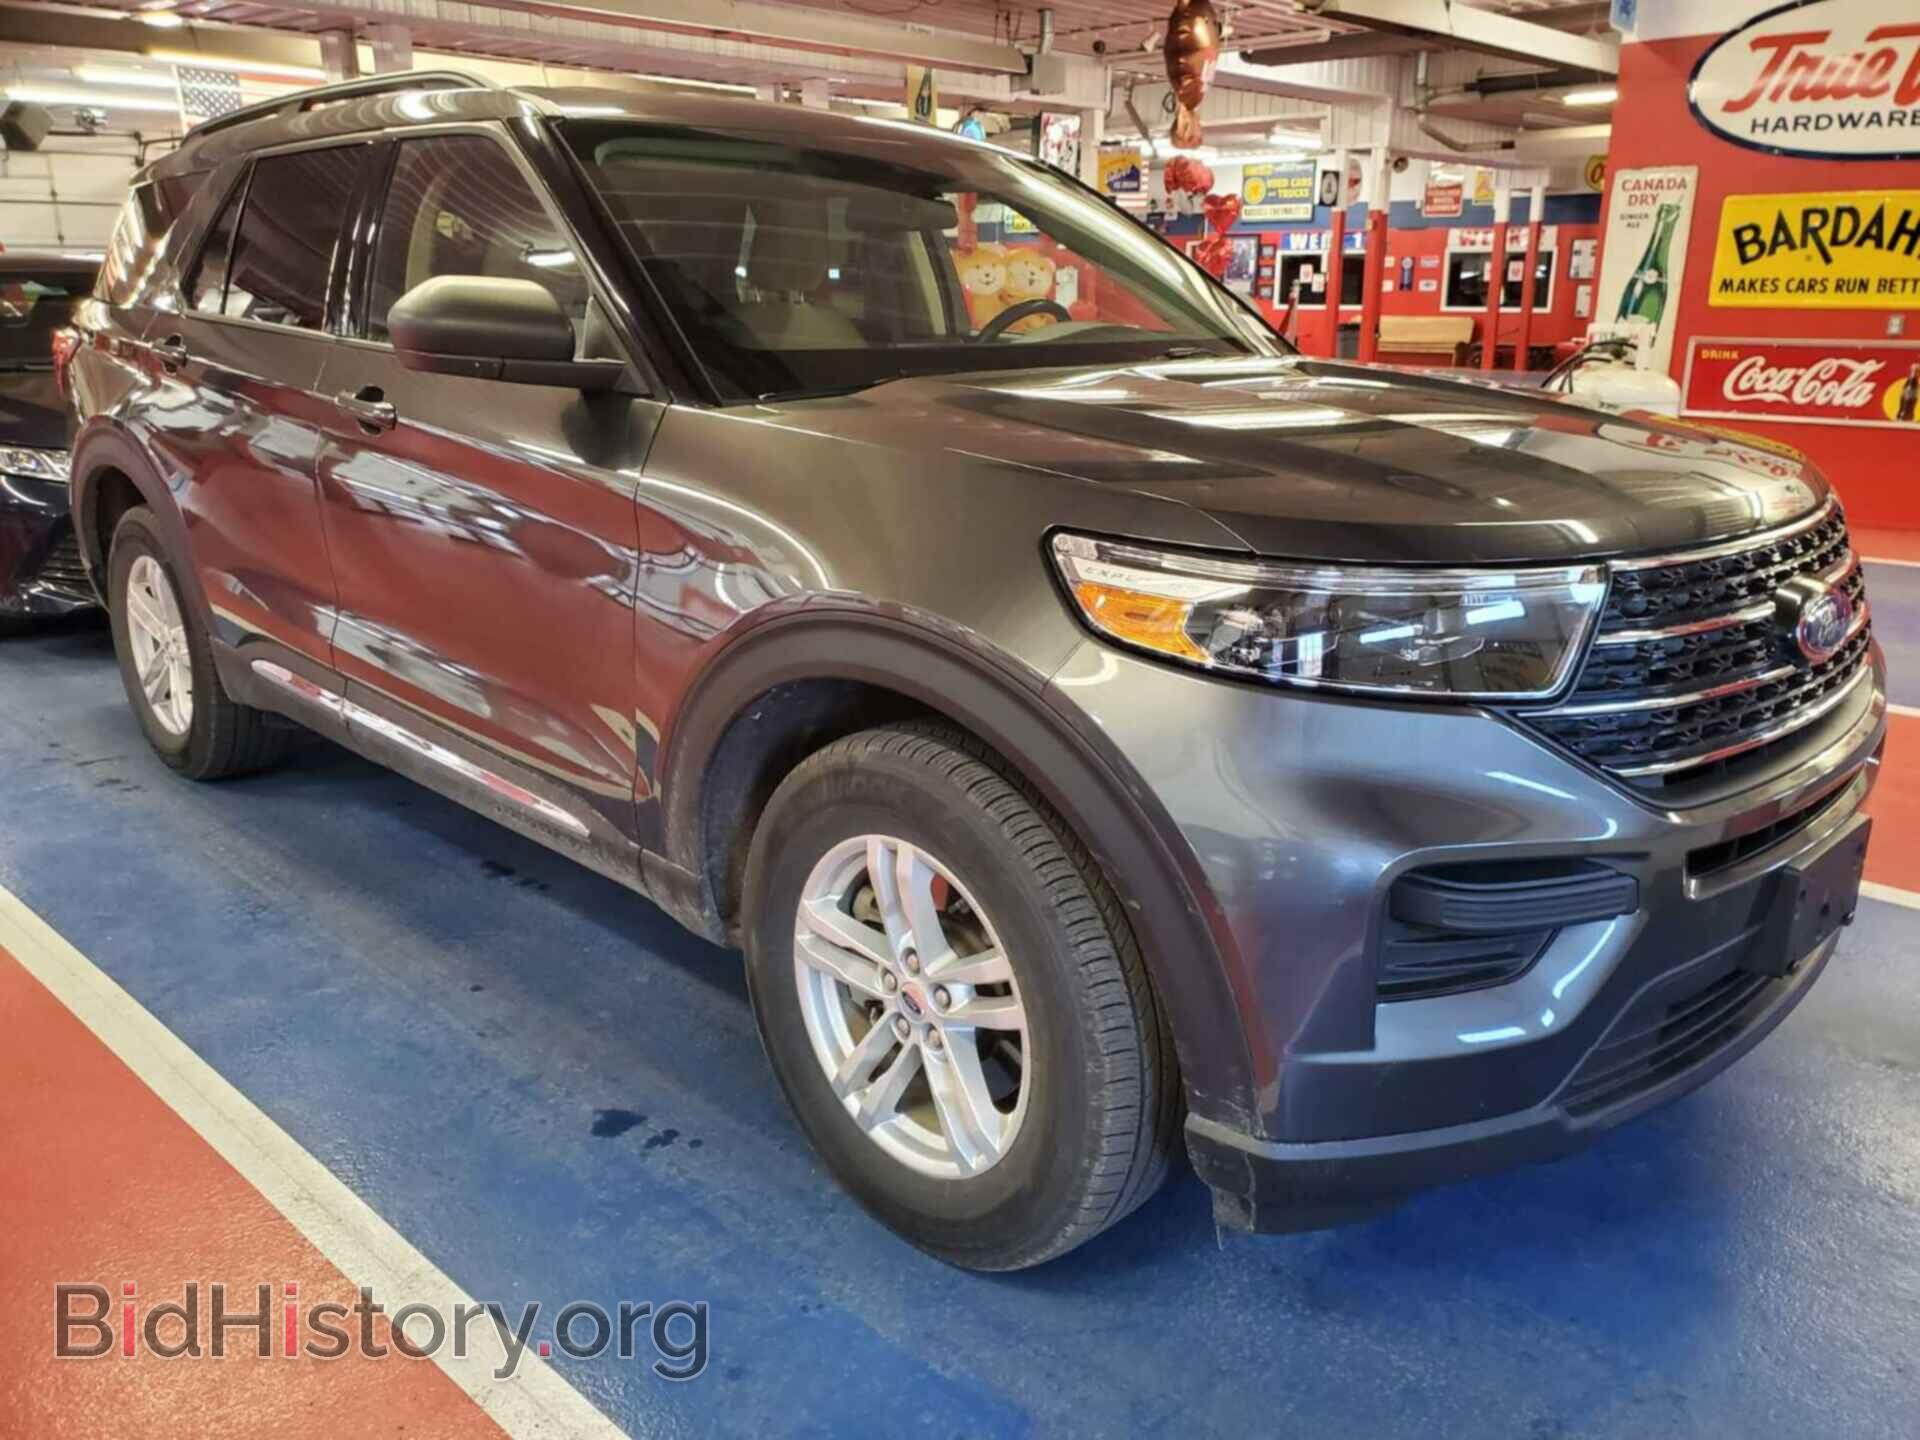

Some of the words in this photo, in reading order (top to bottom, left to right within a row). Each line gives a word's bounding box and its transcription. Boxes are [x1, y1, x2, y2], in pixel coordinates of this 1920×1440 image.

[1722, 29, 1898, 113] True
[1621, 176, 1688, 192] CANADA
[1627, 192, 1659, 207] DRY
[1732, 203, 1920, 266] BARDAH
[1718, 277, 1779, 294] MAKES
[1784, 277, 1828, 294] CARS
[1834, 277, 1870, 294] RUN
[1700, 348, 1739, 360] DRINK
